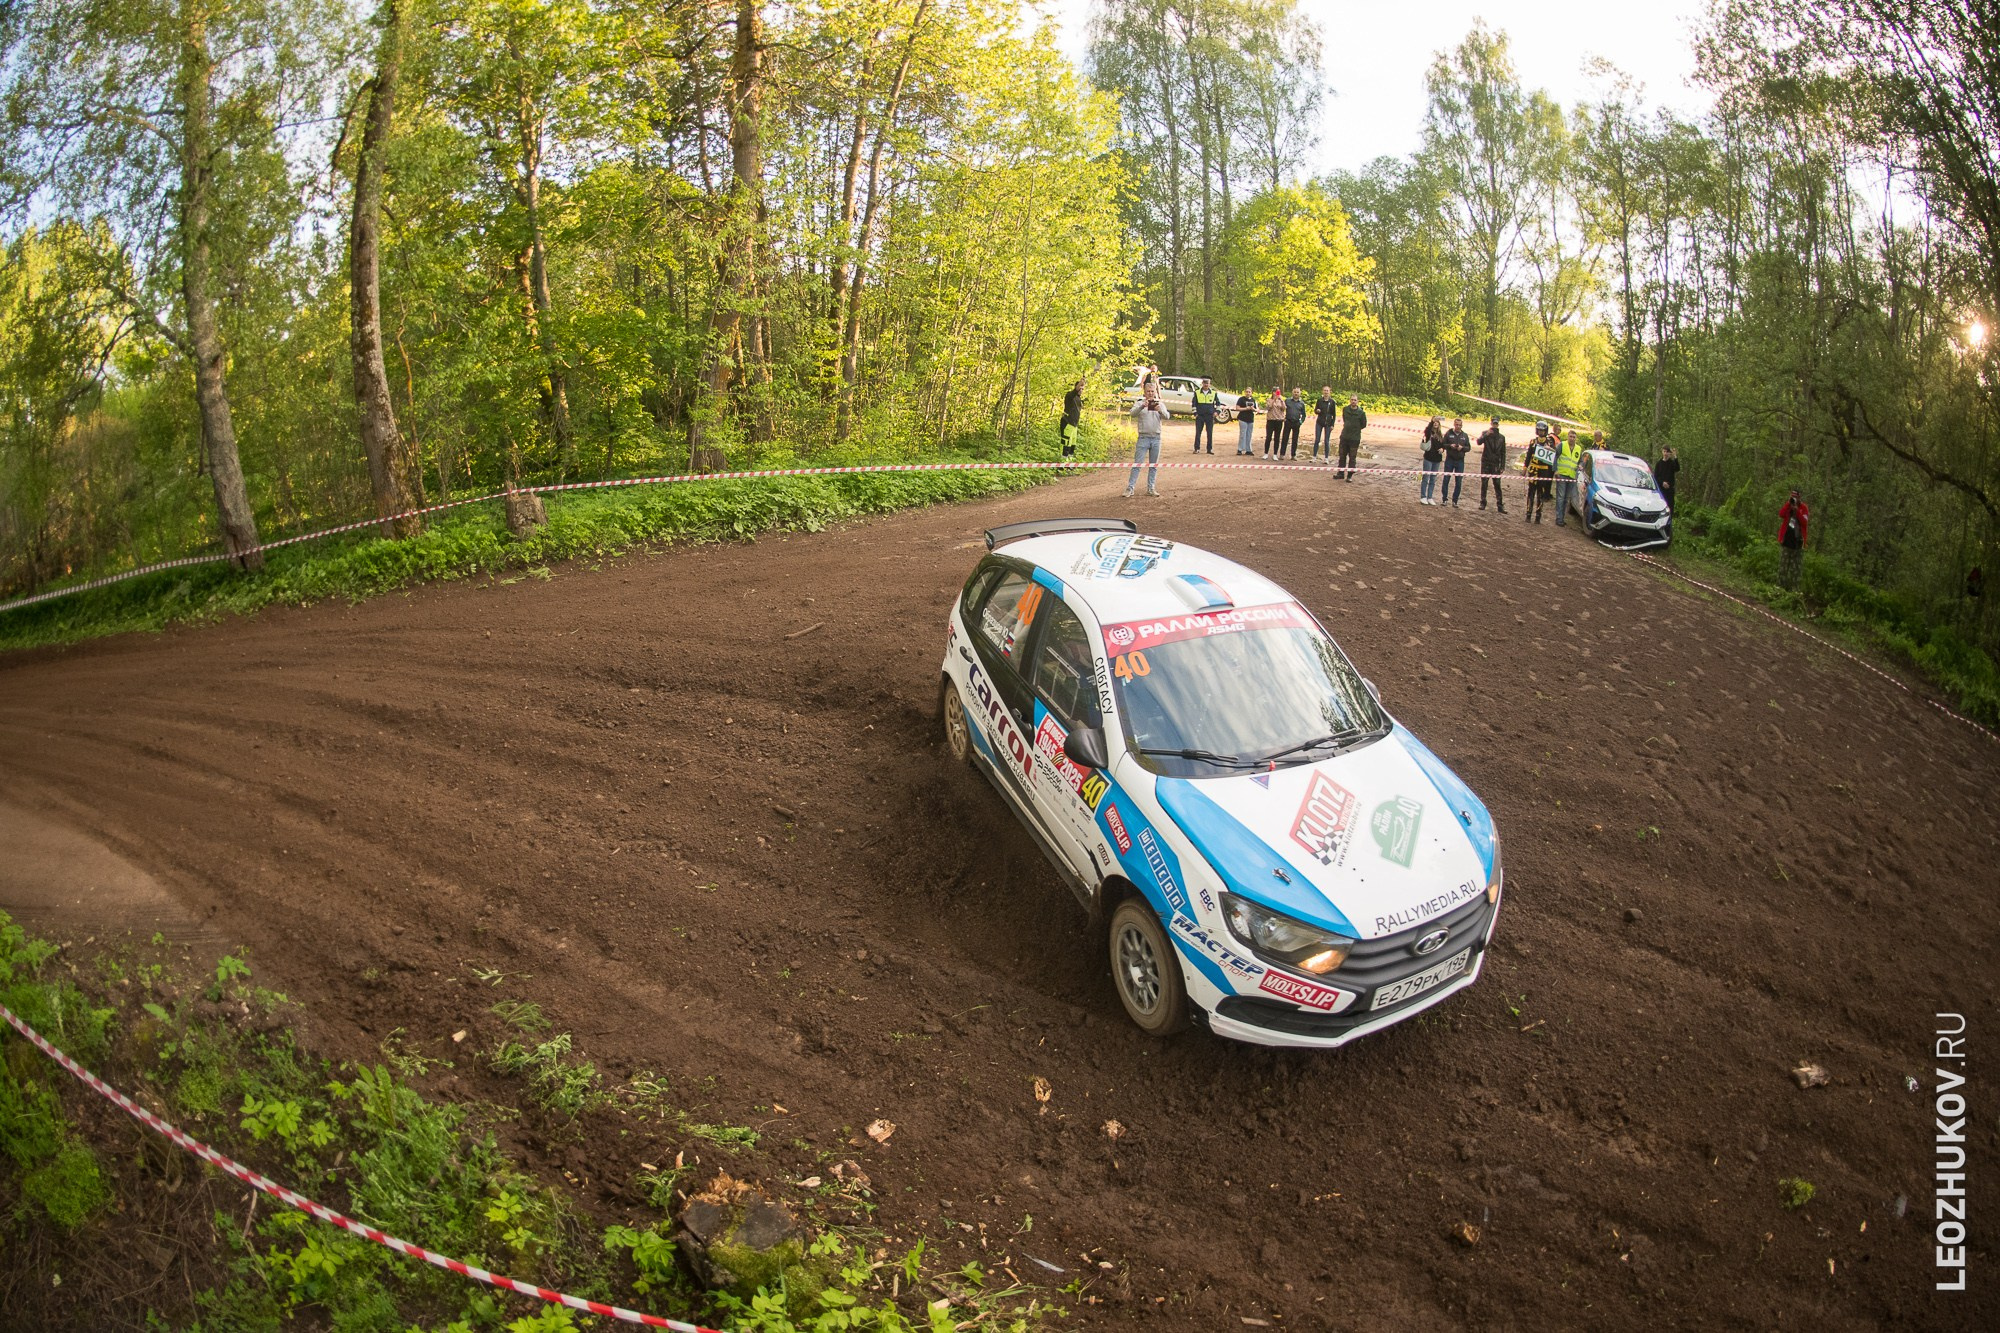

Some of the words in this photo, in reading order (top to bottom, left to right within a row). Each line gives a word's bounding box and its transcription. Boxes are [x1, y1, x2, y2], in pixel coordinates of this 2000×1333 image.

[1537, 448, 1553, 462] OK
[1017, 583, 1043, 625] 40
[1138, 612, 1214, 638] РАЛЛИ
[1219, 608, 1289, 625] РОССИИ
[1114, 651, 1151, 681] 40
[1038, 731, 1058, 760] 1945
[1060, 758, 1083, 792] 2025
[1082, 774, 1106, 809] 40
[1295, 775, 1348, 853] KLOTZ
[1396, 797, 1421, 819] 40
[1106, 806, 1131, 850] MOLYSLIP
[1199, 888, 1216, 912] EBC
[1375, 879, 1477, 931] RALLYMEDIA.RU
[1262, 973, 1338, 1007] MOLYSLIP
